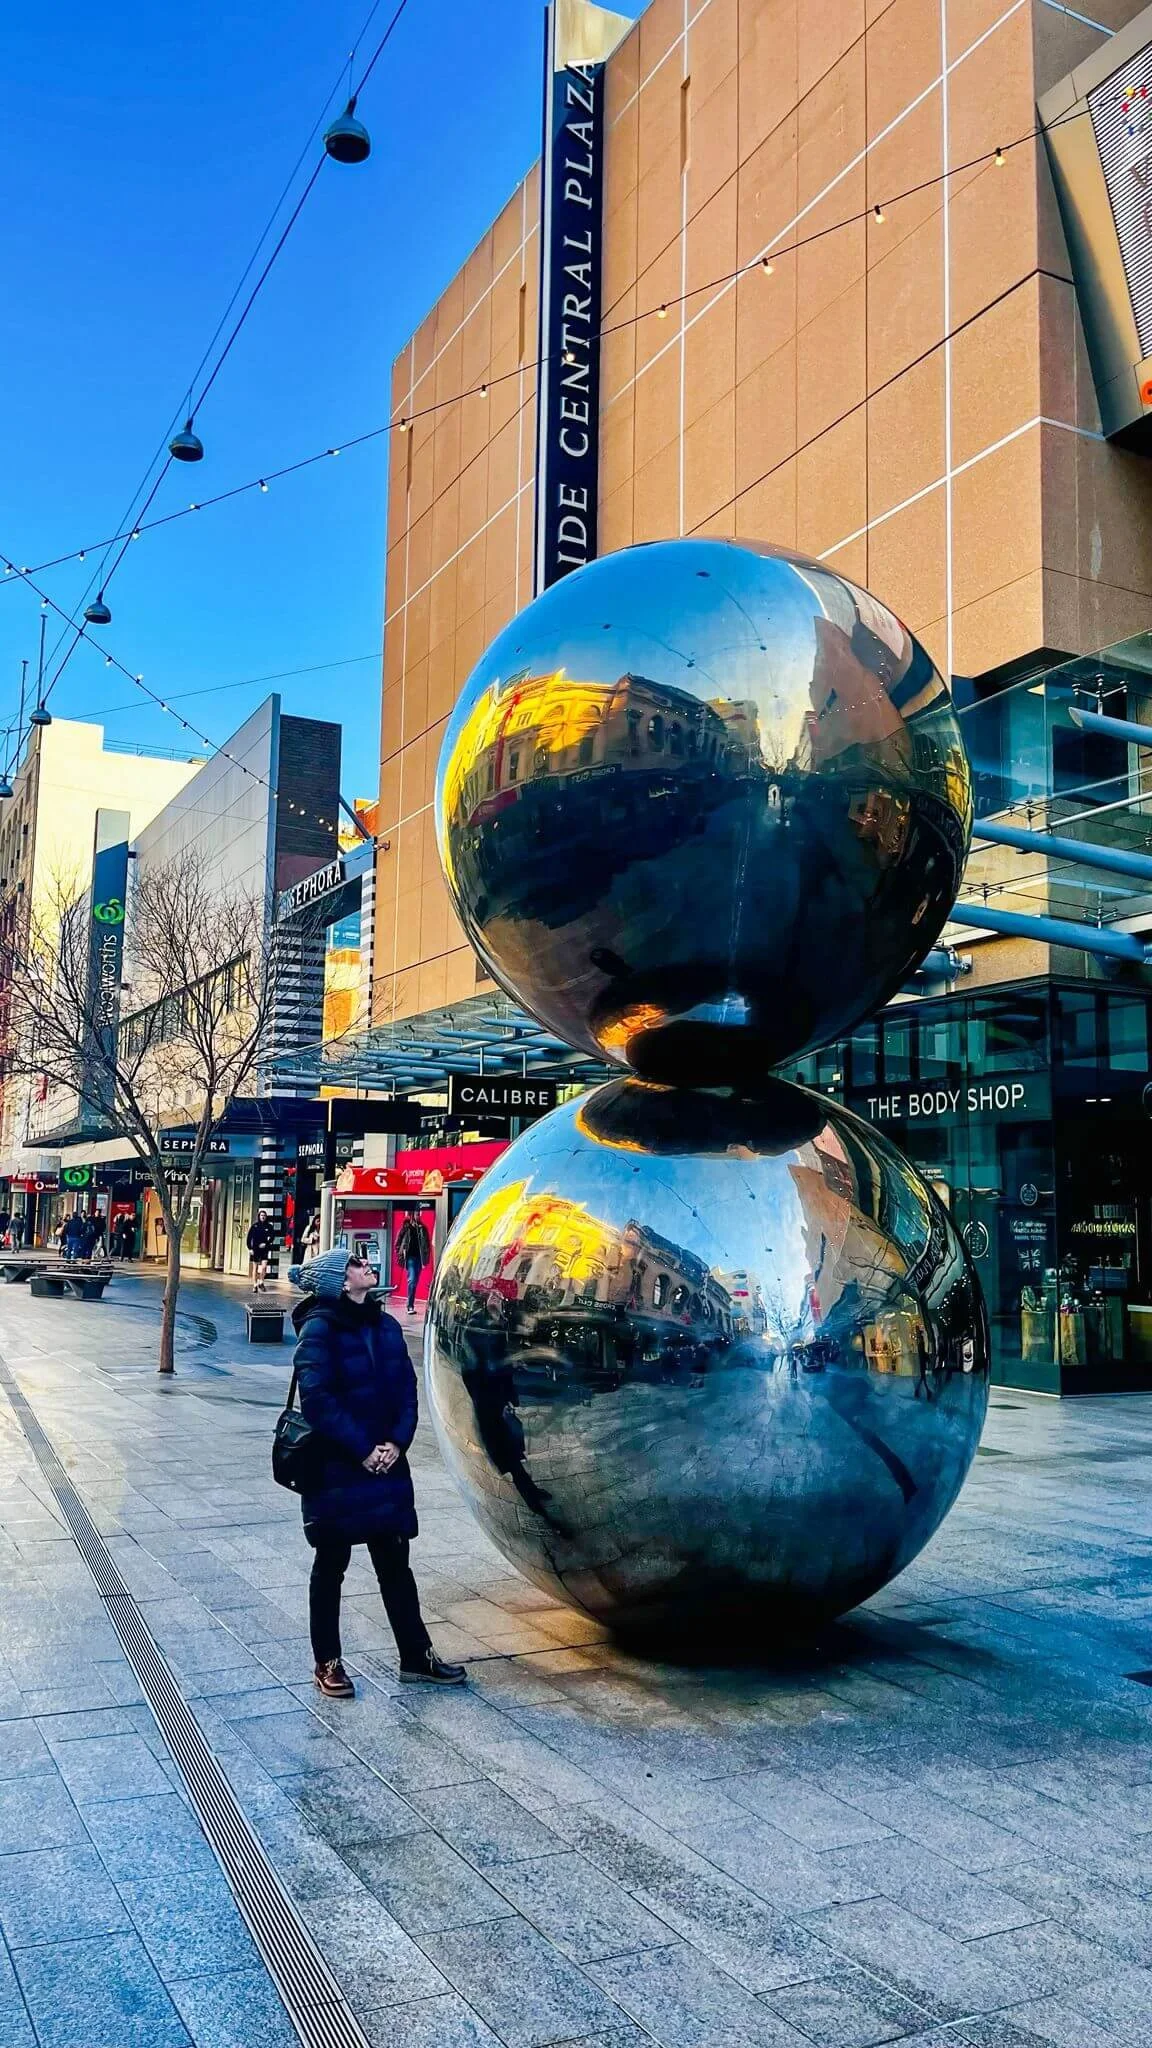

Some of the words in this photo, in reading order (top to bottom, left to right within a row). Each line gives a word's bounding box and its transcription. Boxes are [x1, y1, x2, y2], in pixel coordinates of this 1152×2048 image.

[564, 58, 595, 210] PLAZA
[559, 230, 592, 457] CENTRAL
[288, 860, 341, 909] SEPHORA
[460, 1087, 549, 1105] CALIBRE
[867, 1096, 902, 1119] THE
[909, 1089, 960, 1116] BODY
[163, 1140, 227, 1151] SEPHRA
[298, 1143, 324, 1157] SEPHORA
